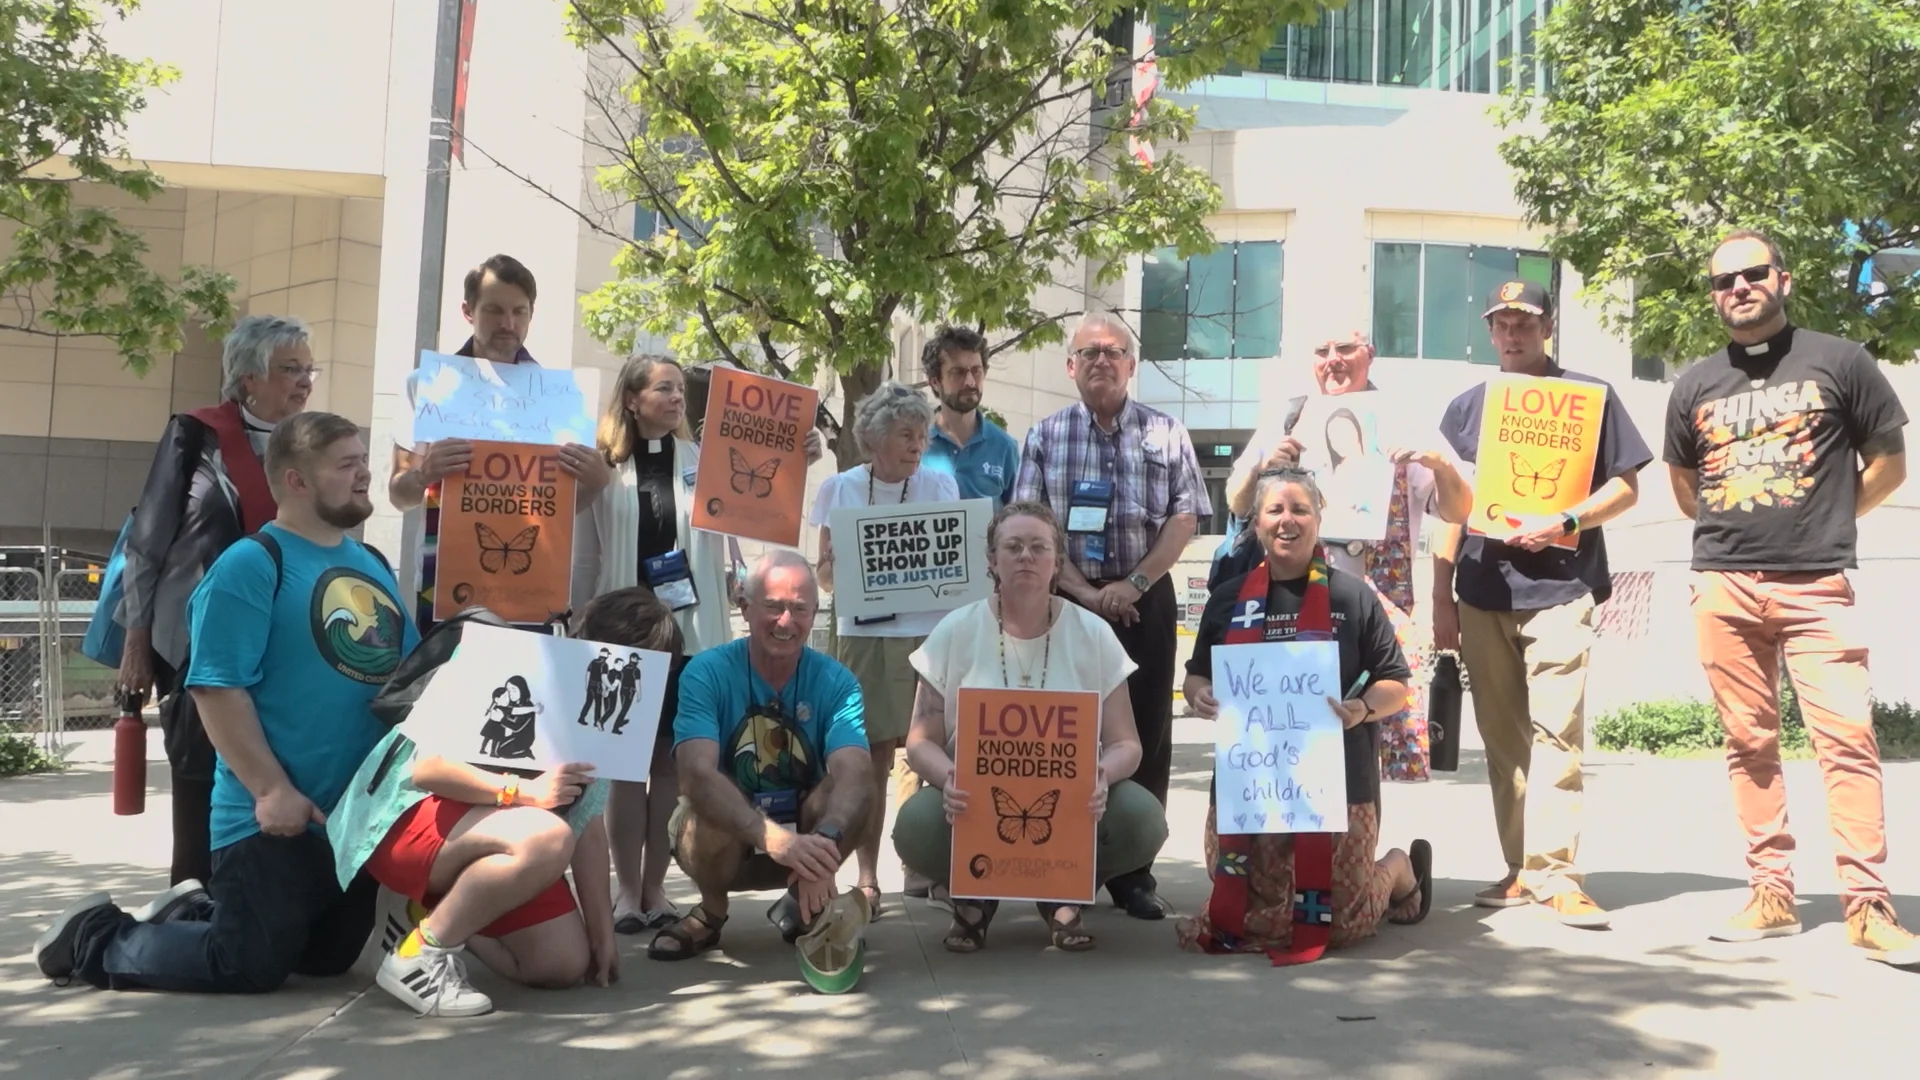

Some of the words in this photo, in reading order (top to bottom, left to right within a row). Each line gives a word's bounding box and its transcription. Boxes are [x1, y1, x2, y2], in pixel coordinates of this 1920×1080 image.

[724, 380, 803, 423] LOVE
[1503, 387, 1587, 421] LOVE
[723, 407, 776, 432] KNOWS
[777, 421, 798, 437] NO
[1501, 414, 1558, 432] KNOWS
[1562, 421, 1583, 436] NO
[719, 422, 796, 452] BORDERS
[1498, 428, 1582, 452] BORDERS
[464, 452, 561, 483] LOVE
[463, 482, 527, 498] KNOWS
[531, 485, 556, 499] NO
[461, 497, 556, 517] BORDERS
[863, 519, 927, 539] SPEAK
[932, 517, 959, 533] UP
[863, 537, 930, 556] STAND
[936, 534, 962, 550] UP
[866, 553, 927, 573] SHOW
[933, 551, 959, 566] UP
[867, 573, 898, 587] FOR
[902, 565, 963, 583] JUSTICE
[1224, 658, 1267, 699] We
[1280, 672, 1324, 695] are
[979, 702, 1078, 739] LOVE
[1246, 701, 1311, 732] ALL
[977, 739, 1046, 757] KNOWS
[1050, 742, 1077, 758] NO
[1228, 740, 1300, 771] God's
[976, 757, 1077, 779] BORDERS
